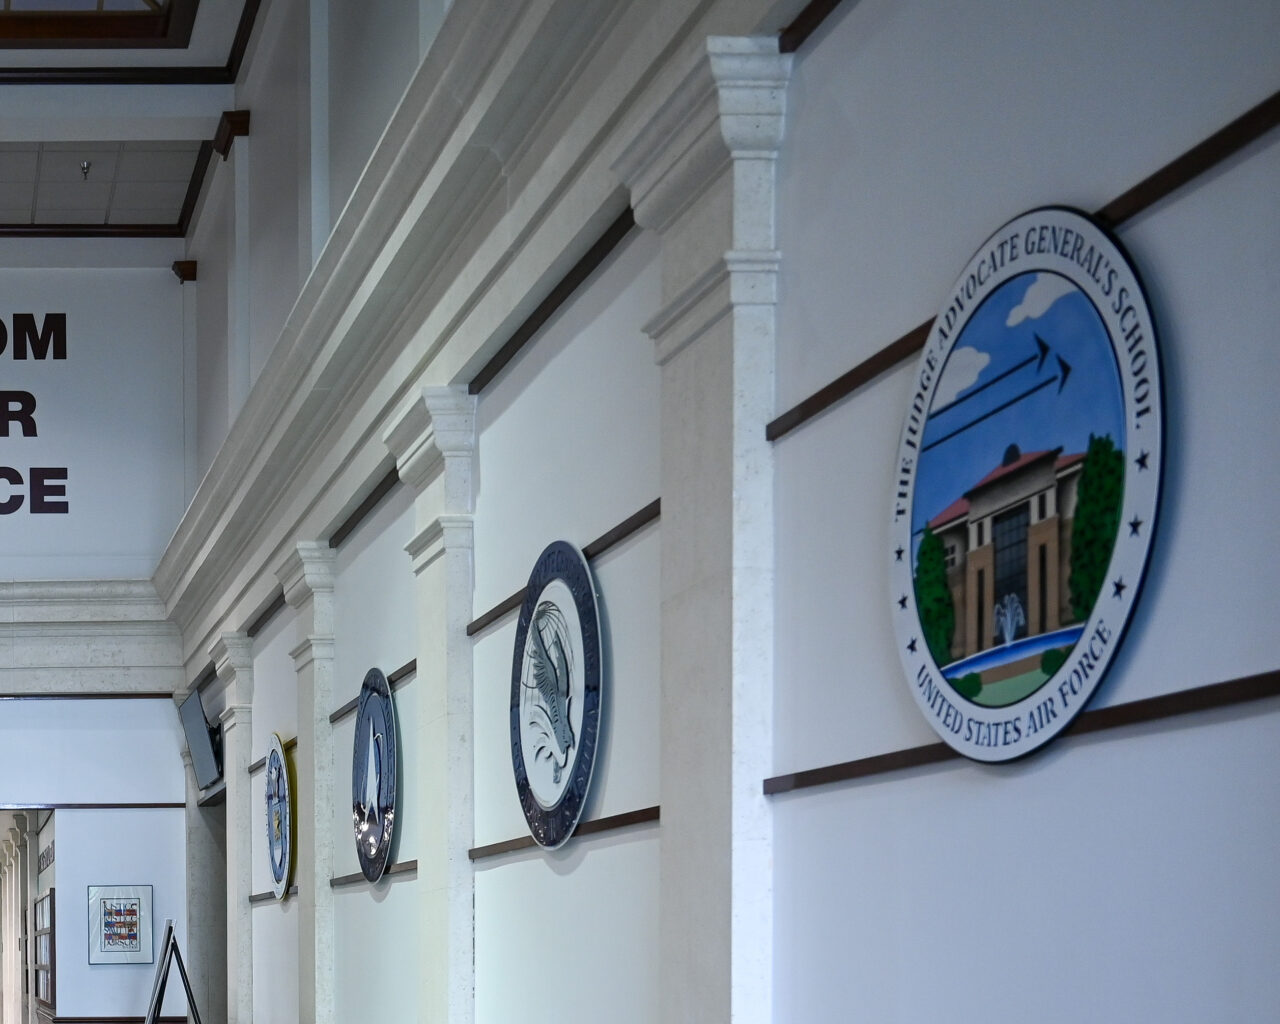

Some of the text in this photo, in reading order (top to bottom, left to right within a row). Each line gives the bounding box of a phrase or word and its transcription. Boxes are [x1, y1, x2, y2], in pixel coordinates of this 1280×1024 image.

[905, 349, 939, 450] JUDGE
[937, 233, 1020, 351] ADVOCATE
[1024, 225, 1119, 297] GENERAL'S
[1111, 286, 1151, 430] SCHOOL
[917, 618, 1112, 748] UNITED STATES AIR FORCE
